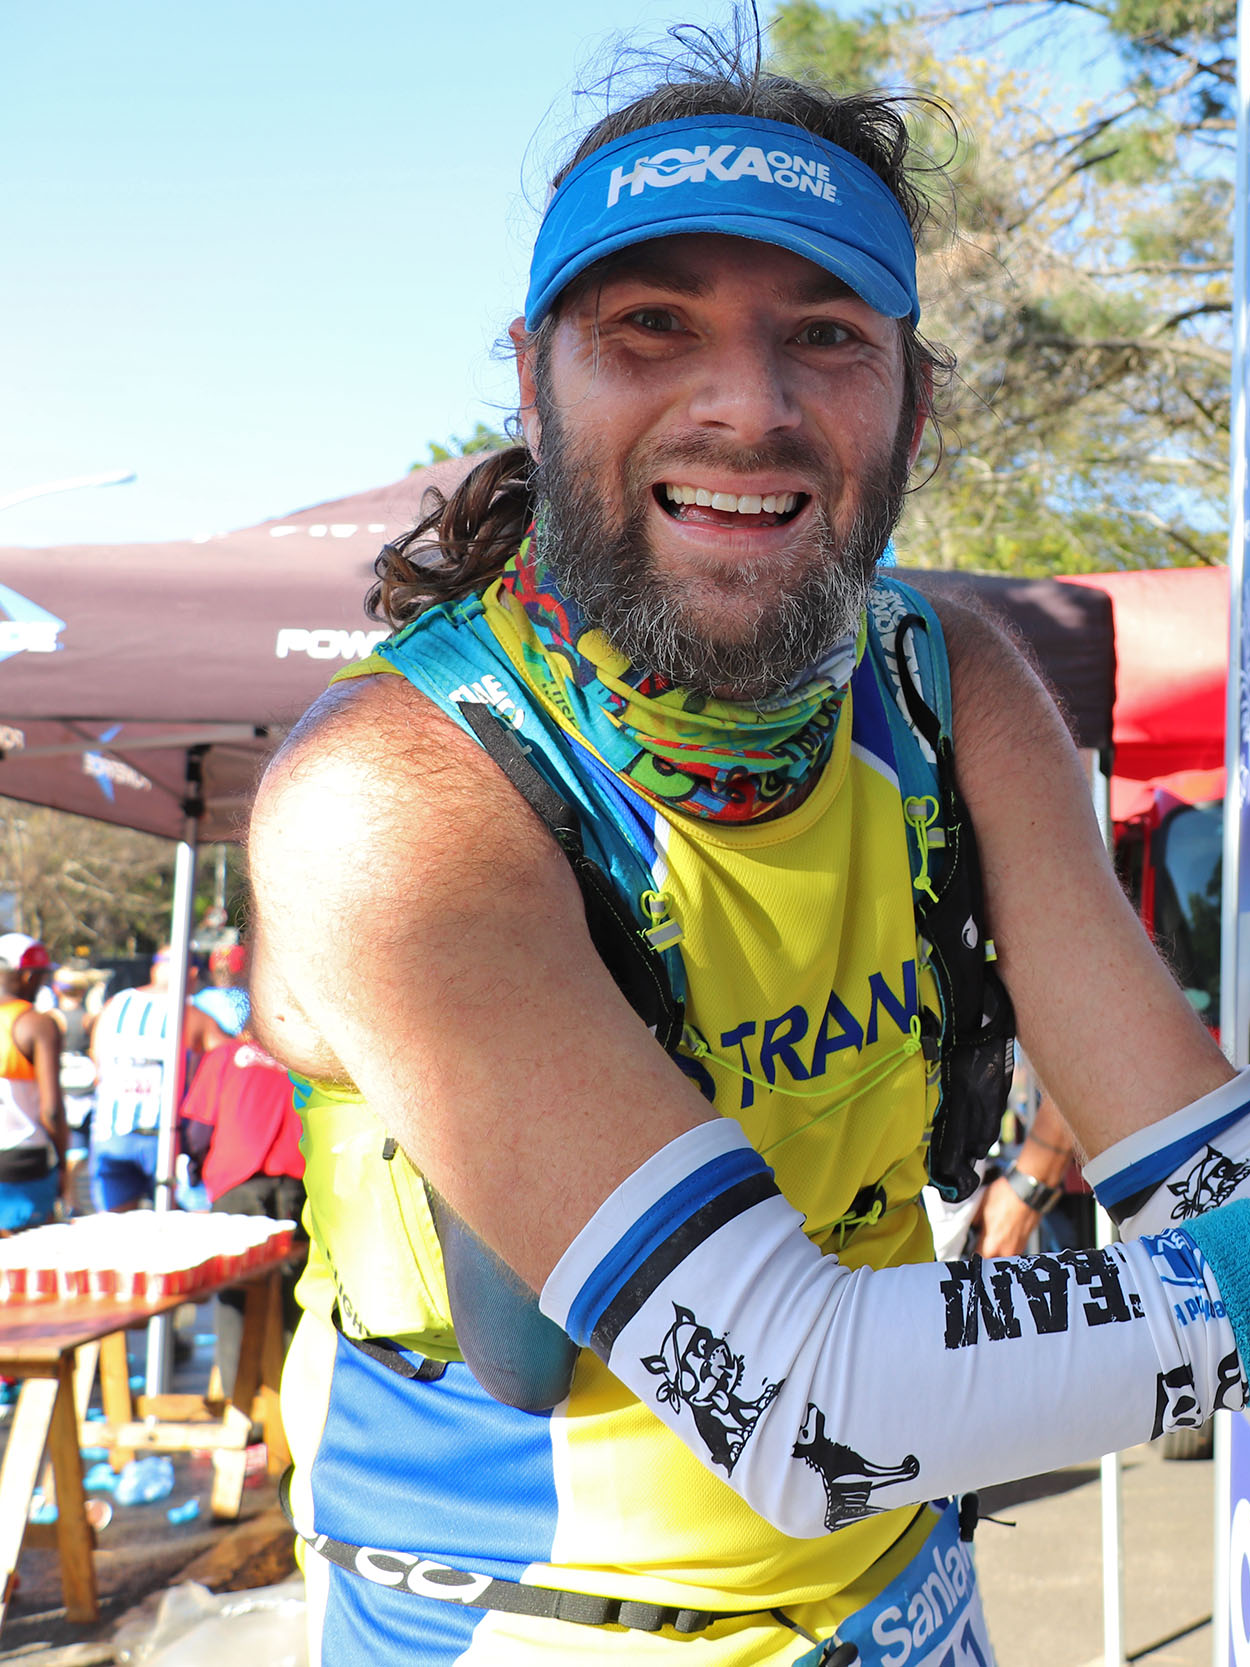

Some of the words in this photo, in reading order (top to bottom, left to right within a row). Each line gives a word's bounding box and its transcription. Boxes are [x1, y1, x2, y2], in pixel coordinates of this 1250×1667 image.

[607, 144, 773, 208] HOKA
[769, 150, 830, 183] ONE
[774, 168, 838, 203] ONE
[276, 628, 391, 660] POW
